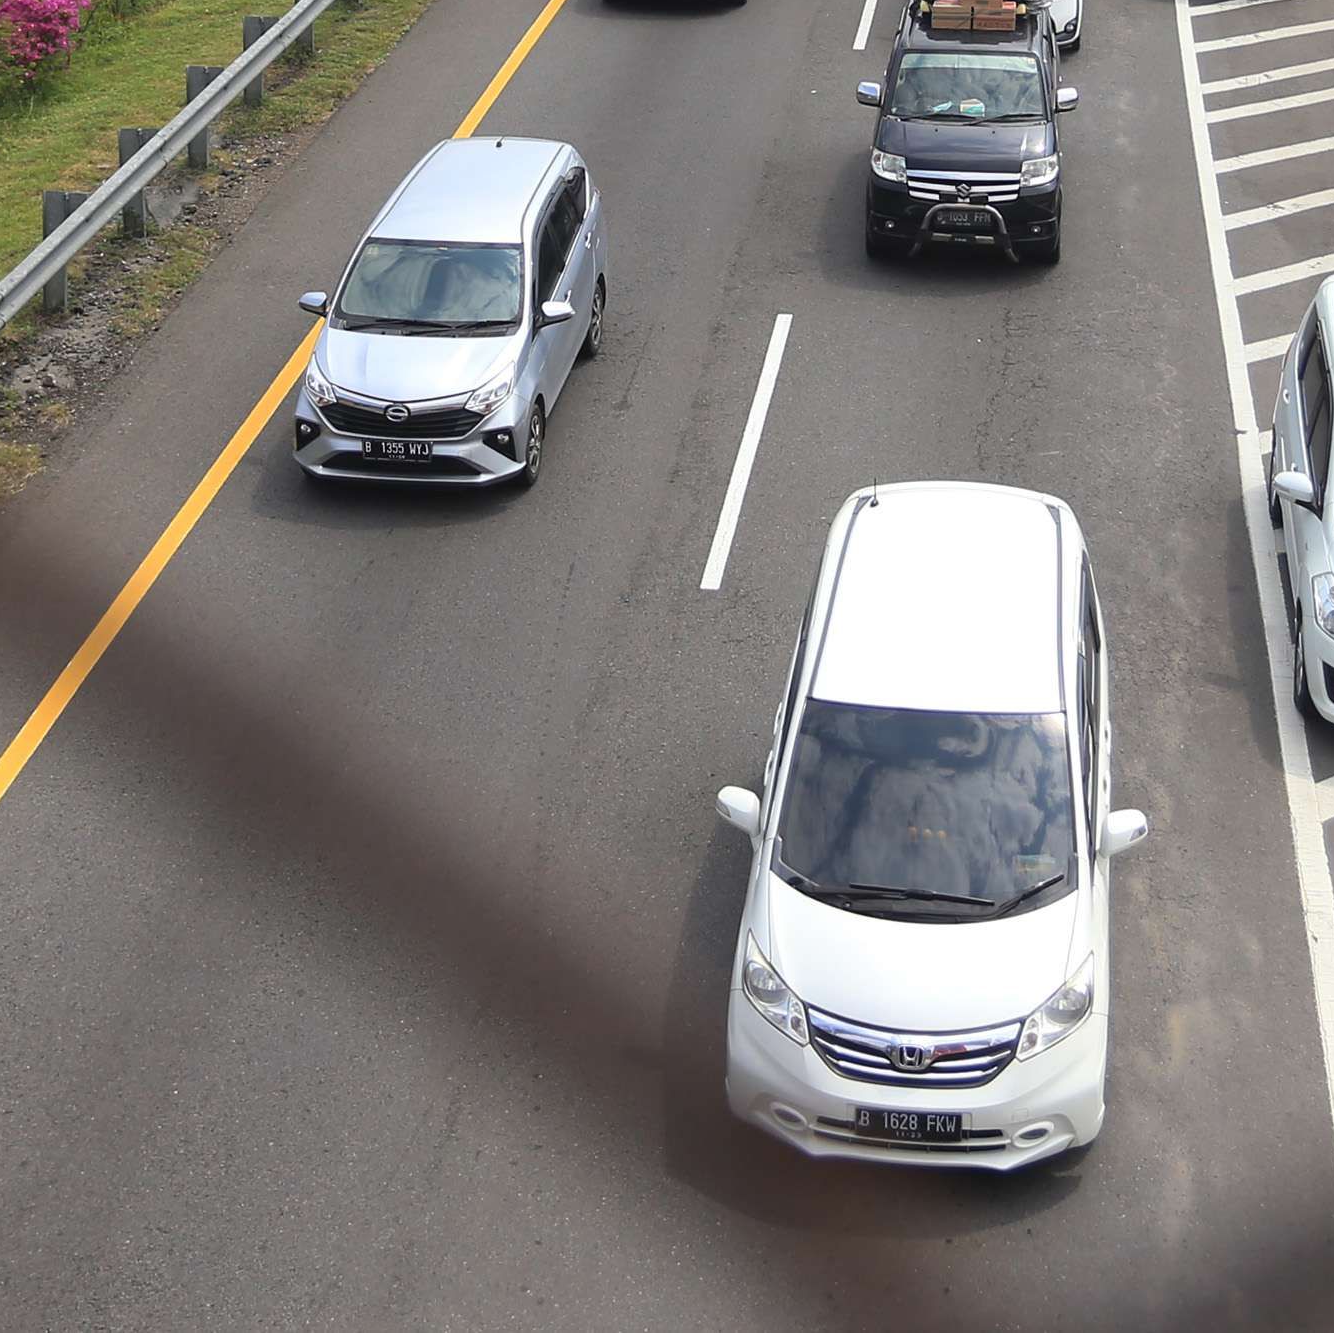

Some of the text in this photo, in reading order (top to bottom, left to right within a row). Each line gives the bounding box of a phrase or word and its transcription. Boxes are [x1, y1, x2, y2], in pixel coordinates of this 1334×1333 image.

[365, 441, 429, 455] B 1355 WYJ
[859, 1110, 956, 1133] B 1628 FKW
